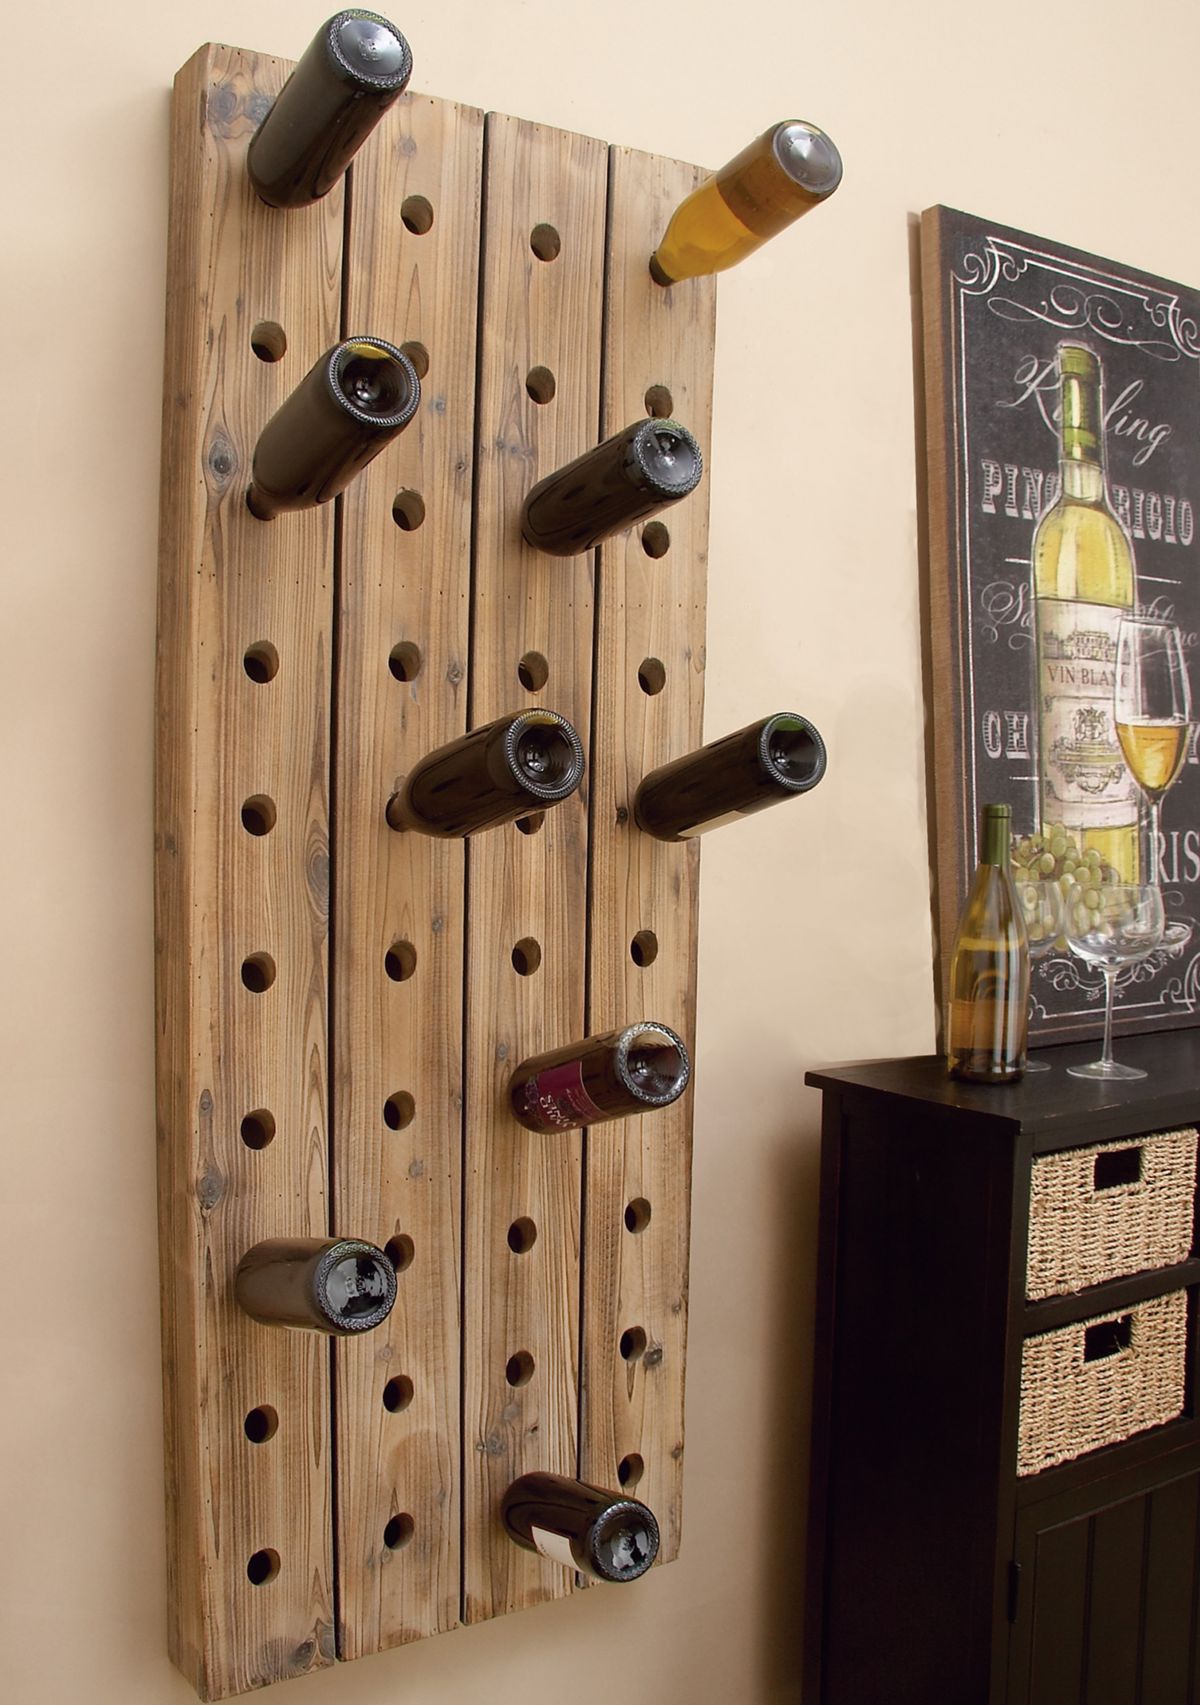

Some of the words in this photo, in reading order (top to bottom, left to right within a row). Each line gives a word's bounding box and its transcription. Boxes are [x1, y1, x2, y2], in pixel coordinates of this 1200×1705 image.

[981, 459, 1060, 519] PINO
[1112, 484, 1194, 546] RIGIO
[1047, 665, 1076, 684] VIN
[1148, 829, 1200, 884] RIS
